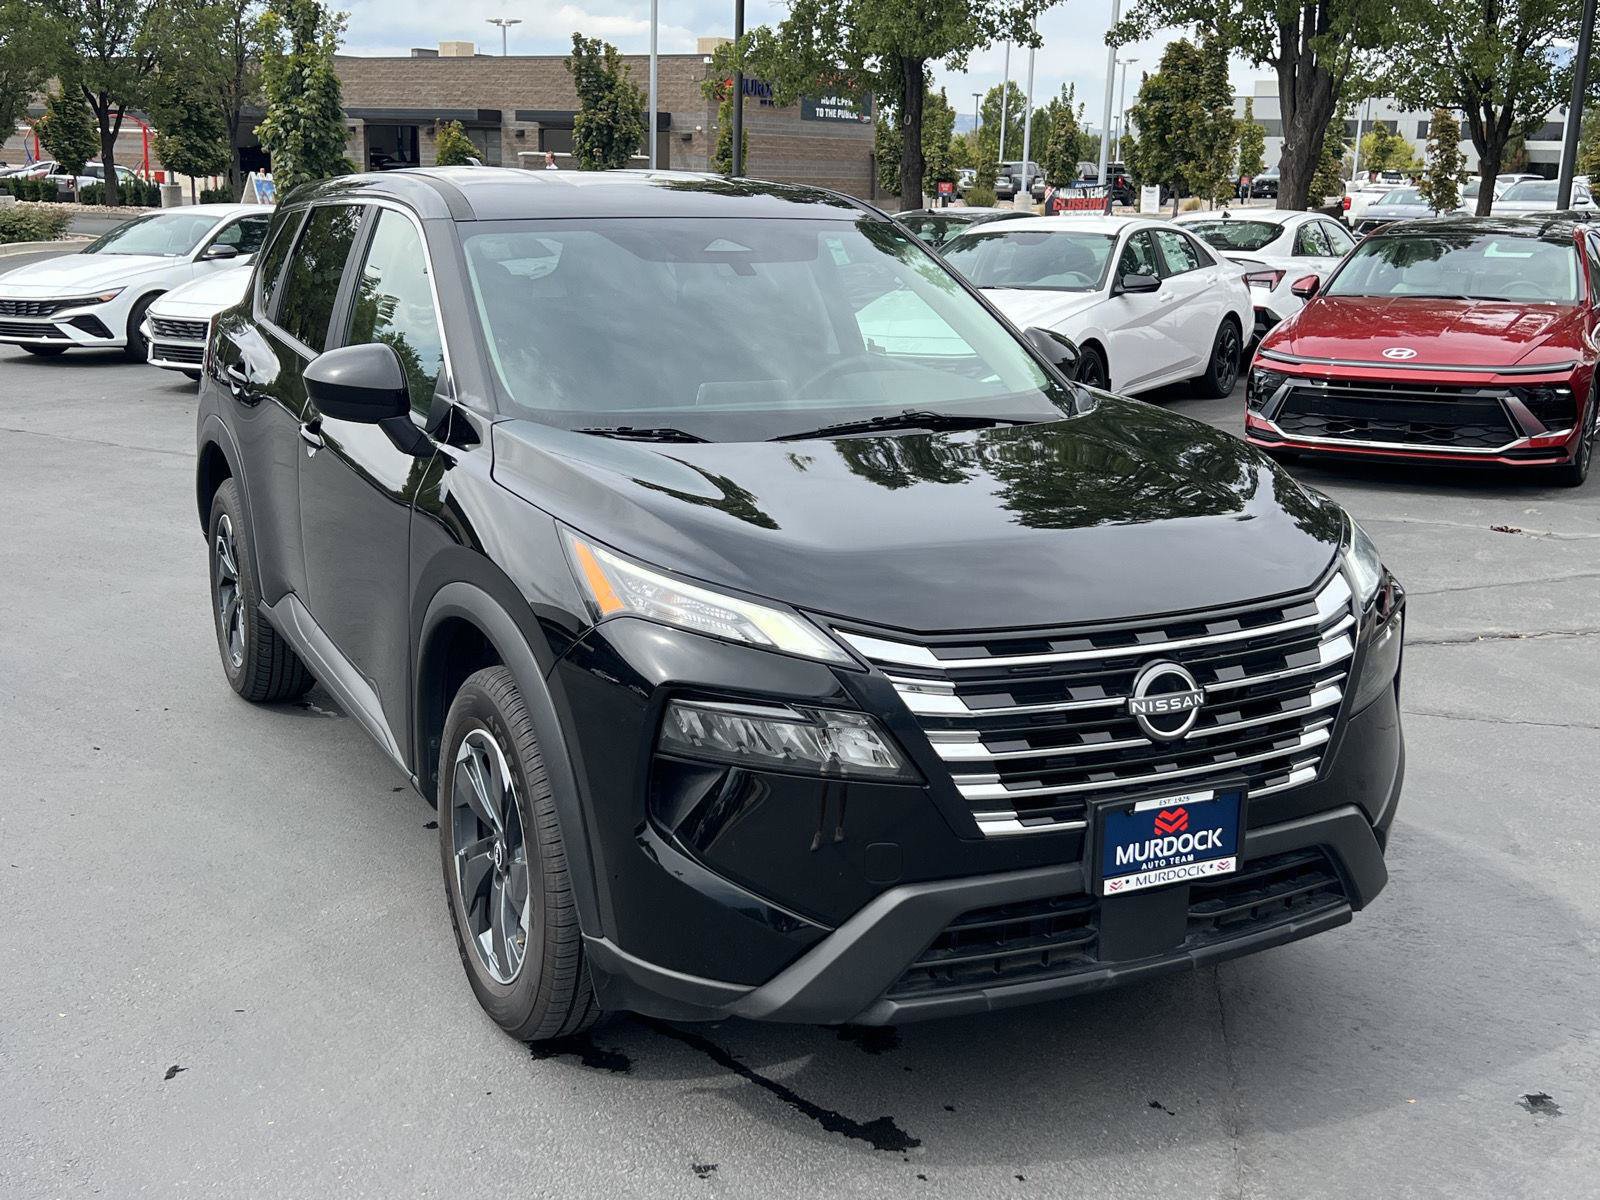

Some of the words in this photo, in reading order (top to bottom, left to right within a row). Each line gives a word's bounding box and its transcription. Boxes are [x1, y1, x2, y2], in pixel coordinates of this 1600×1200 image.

[815, 107, 825, 118] TO
[825, 108, 837, 118] THE
[1060, 187, 1084, 198] MODEL
[1132, 692, 1204, 713] NISSAN
[1116, 828, 1222, 865] MURDOCK
[1141, 859, 1166, 870] AUTO
[1169, 854, 1195, 865] TEAM
[1135, 864, 1206, 887] MURDOCK
